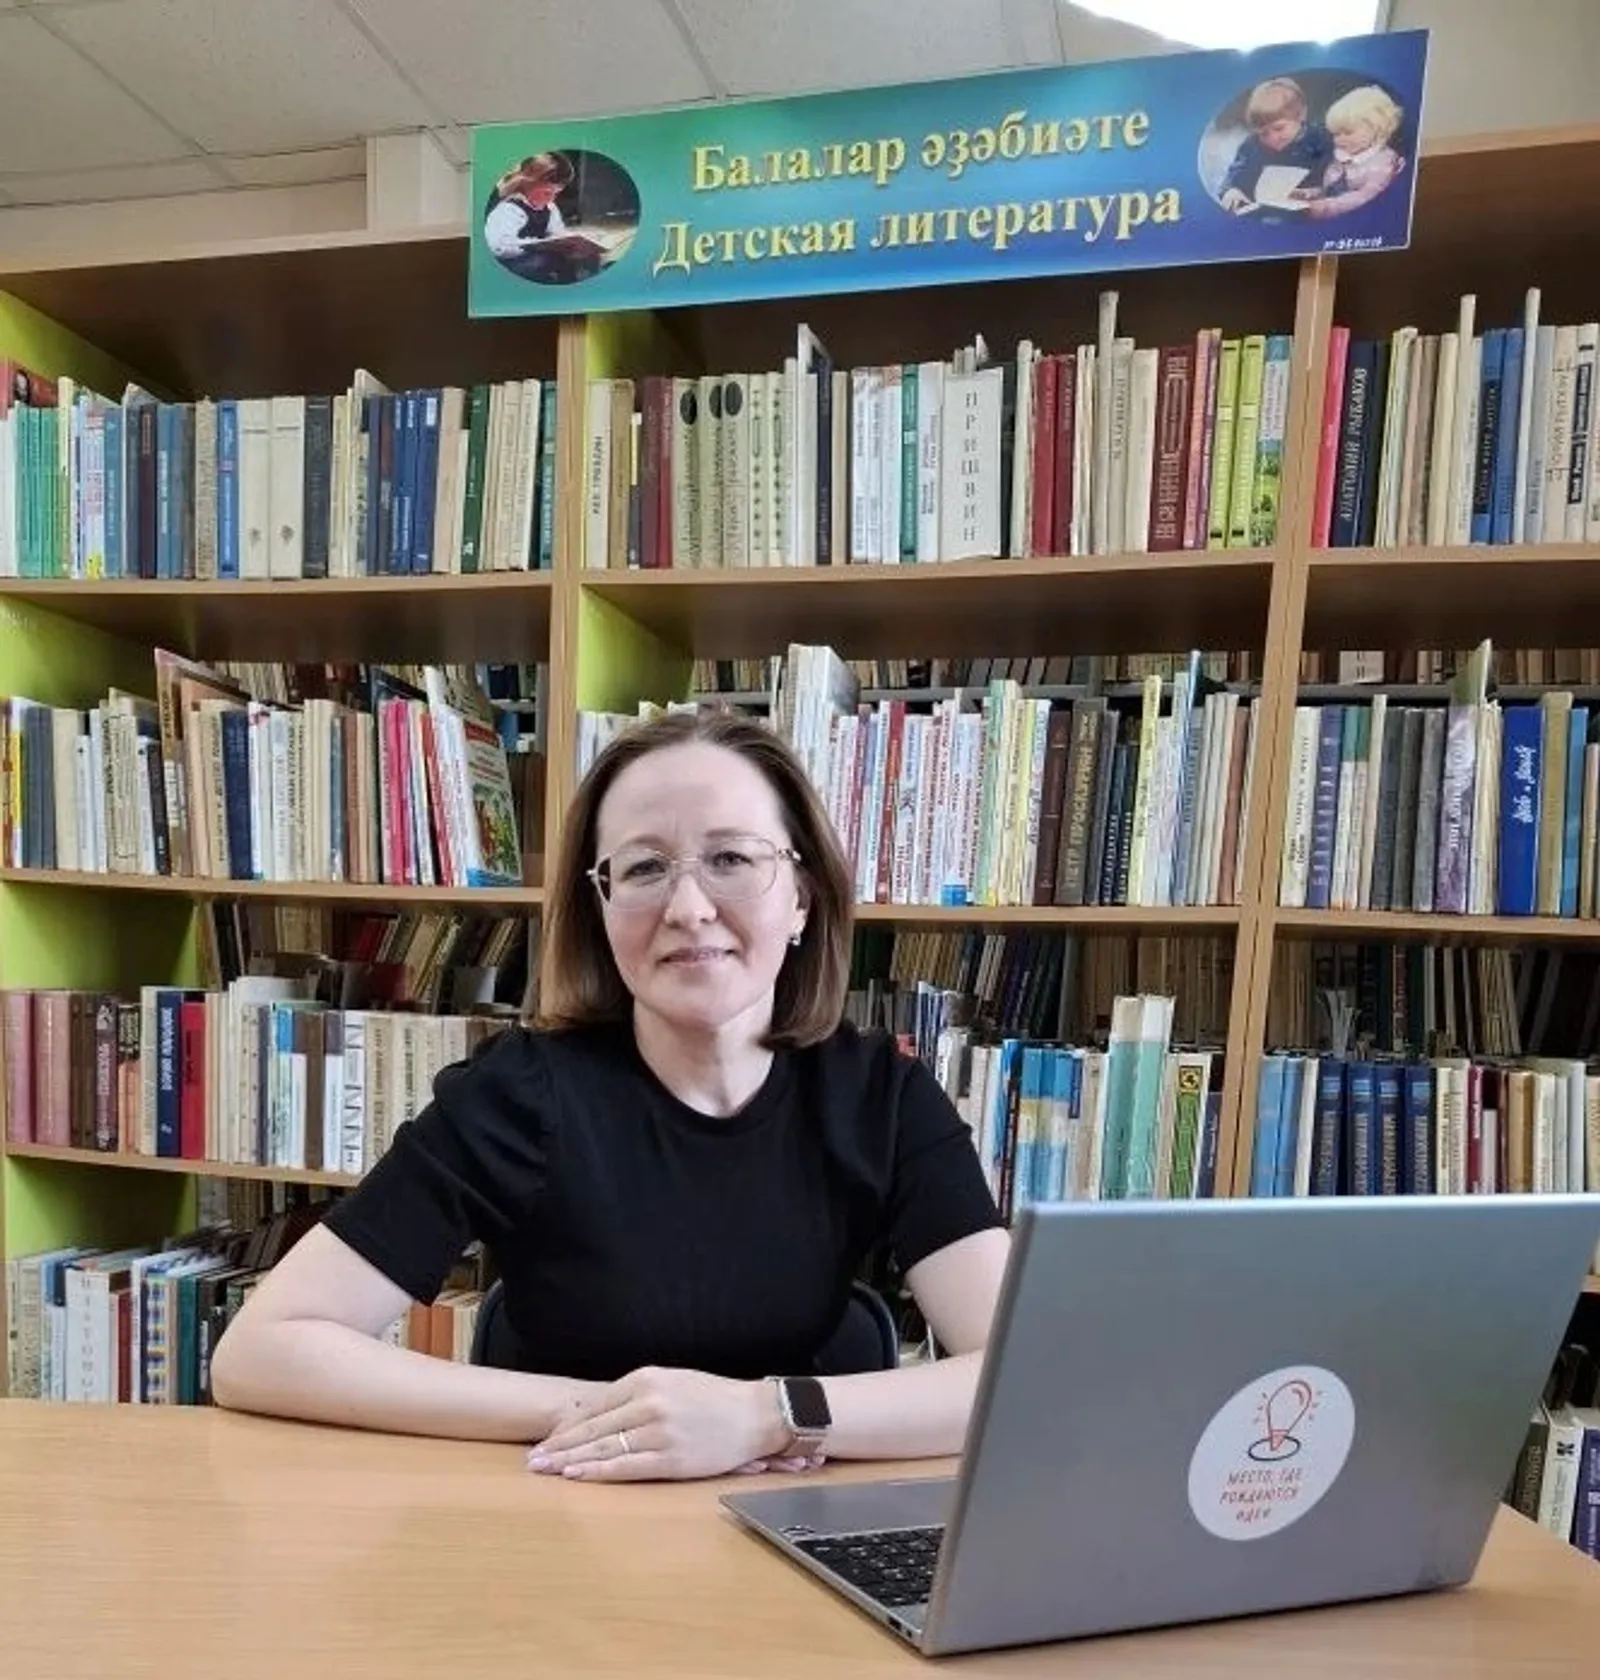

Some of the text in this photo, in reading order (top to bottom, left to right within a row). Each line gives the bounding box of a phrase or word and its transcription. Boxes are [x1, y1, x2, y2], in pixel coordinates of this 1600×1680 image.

[691, 109, 1151, 192] Балалар әҙәбиәте
[652, 186, 1182, 279] Детская литература
[961, 391, 980, 542] ПРИШВИН
